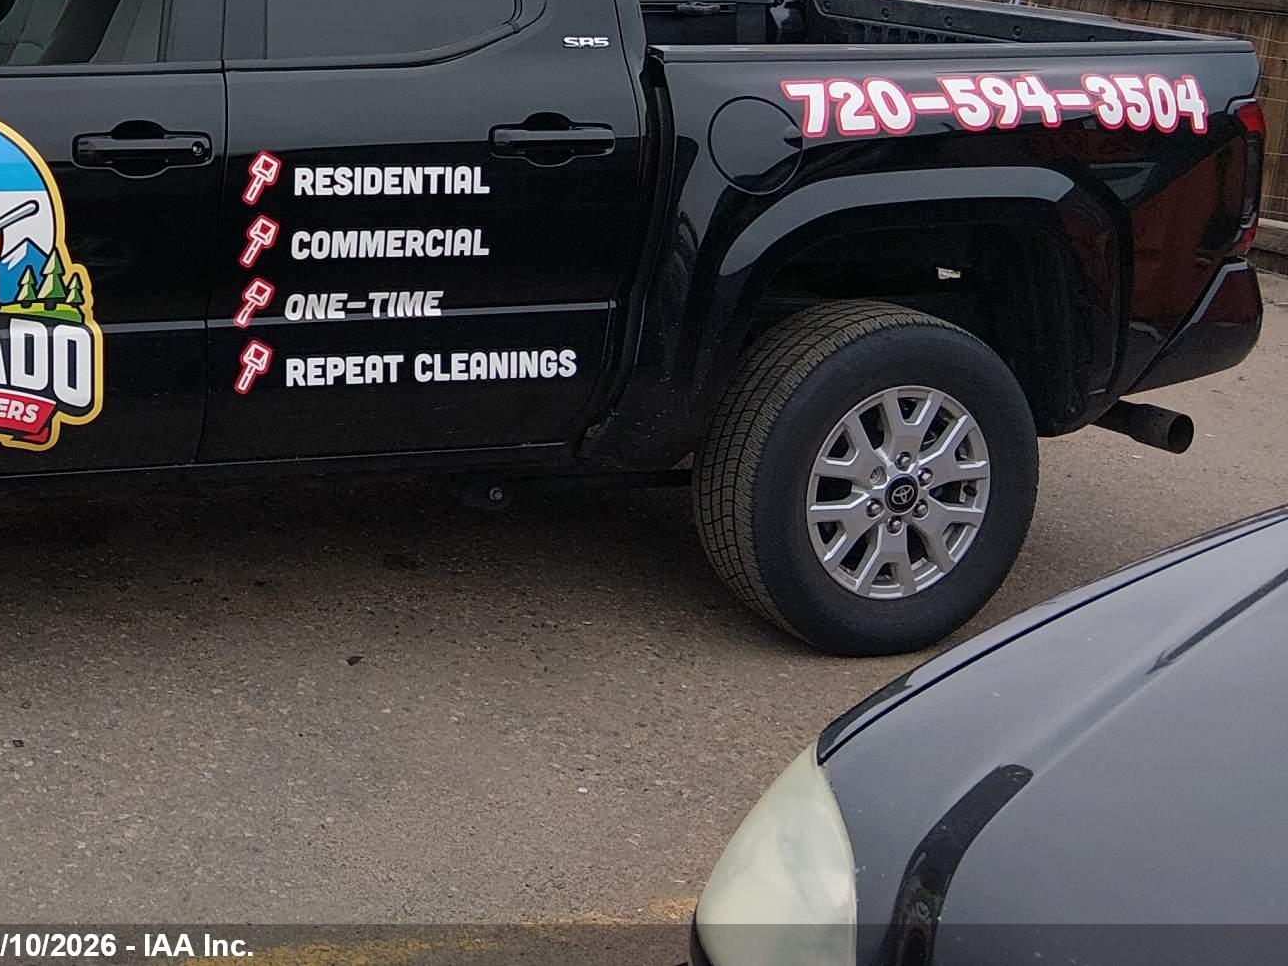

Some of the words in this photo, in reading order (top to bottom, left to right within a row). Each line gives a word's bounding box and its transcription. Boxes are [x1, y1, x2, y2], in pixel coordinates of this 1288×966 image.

[563, 36, 609, 47] SR5
[781, 74, 1208, 137] 720-594-3504
[293, 166, 490, 196] RESIDENTIAL
[290, 228, 489, 260] COMMERCIAL
[284, 290, 444, 321] ONE-TIME
[285, 355, 404, 387] REPEAT
[413, 349, 578, 383] CLEANINGS
